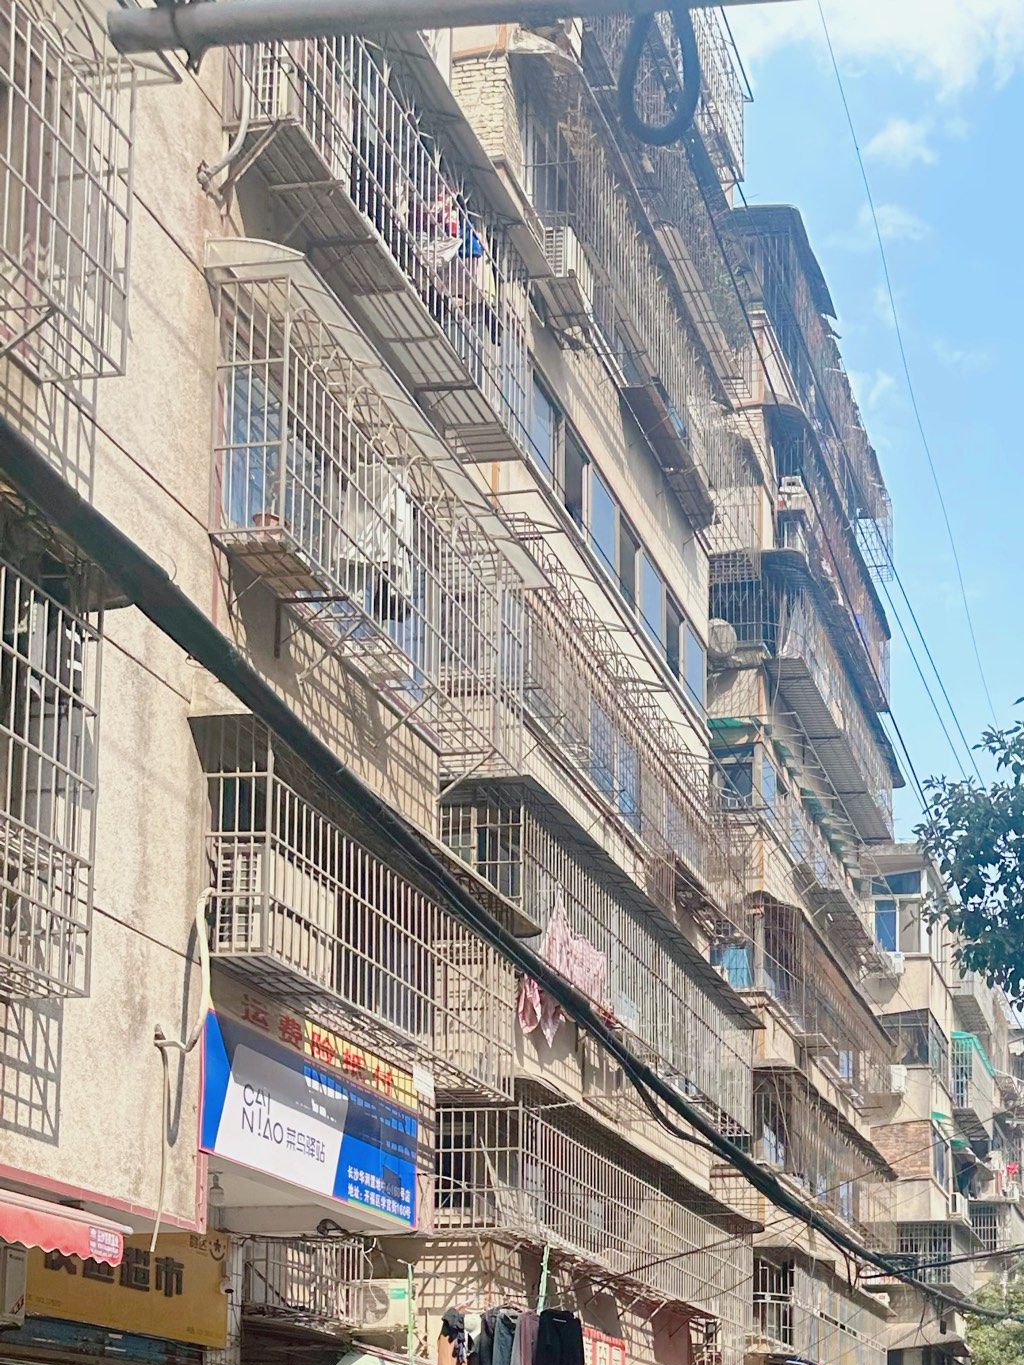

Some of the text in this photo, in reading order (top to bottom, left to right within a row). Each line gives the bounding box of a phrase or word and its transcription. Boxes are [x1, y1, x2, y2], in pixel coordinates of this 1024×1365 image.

[243, 1083, 271, 1115] CAI
[286, 1126, 326, 1163] 菜鸟驿站
